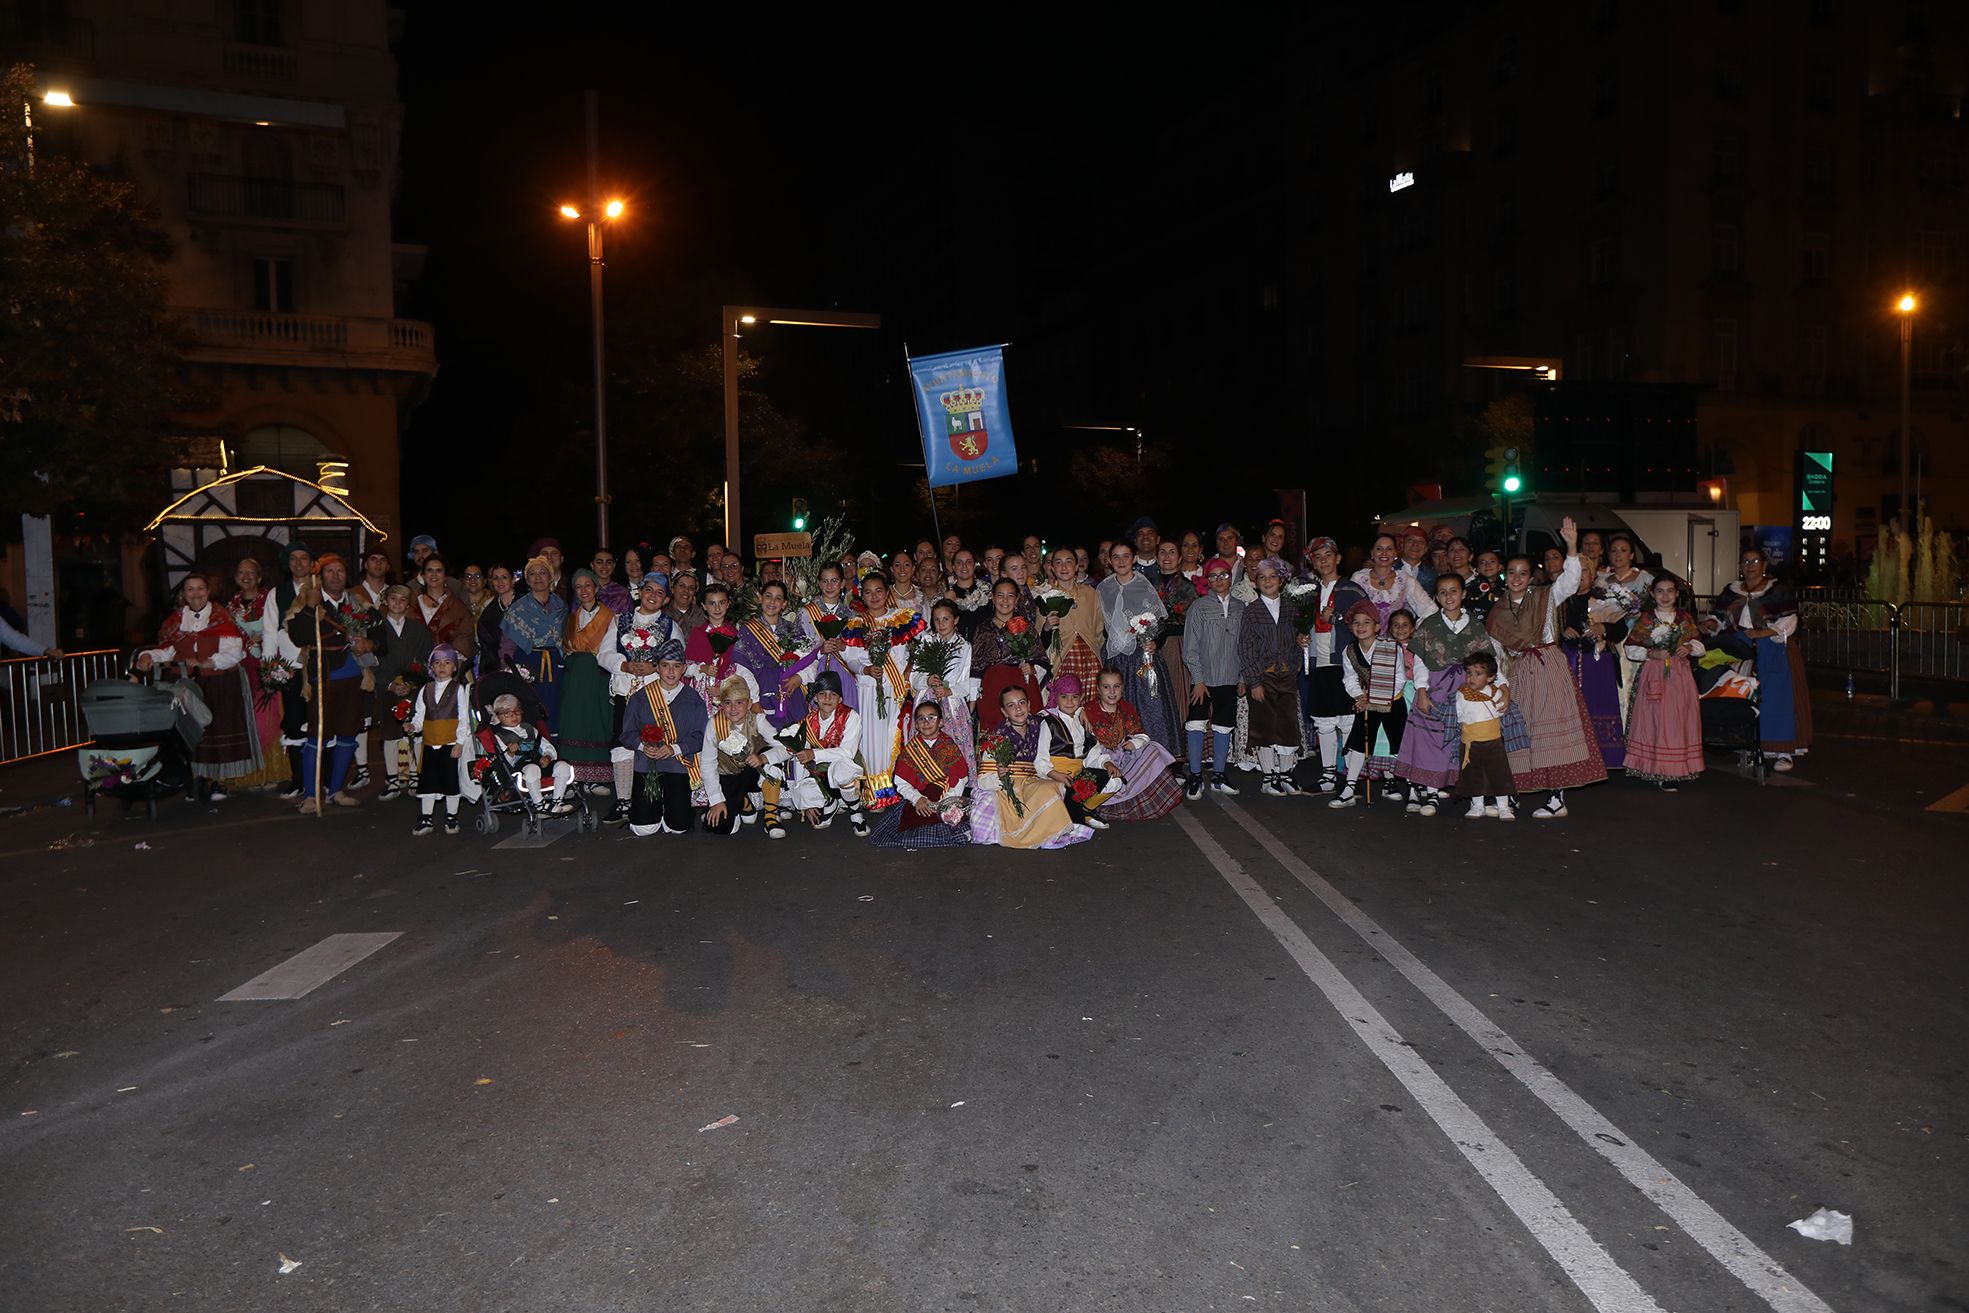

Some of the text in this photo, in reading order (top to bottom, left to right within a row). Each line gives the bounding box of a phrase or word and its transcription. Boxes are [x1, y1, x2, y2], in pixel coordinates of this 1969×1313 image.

[1802, 515, 1831, 530] 22:00
[768, 541, 810, 551] La Muela
